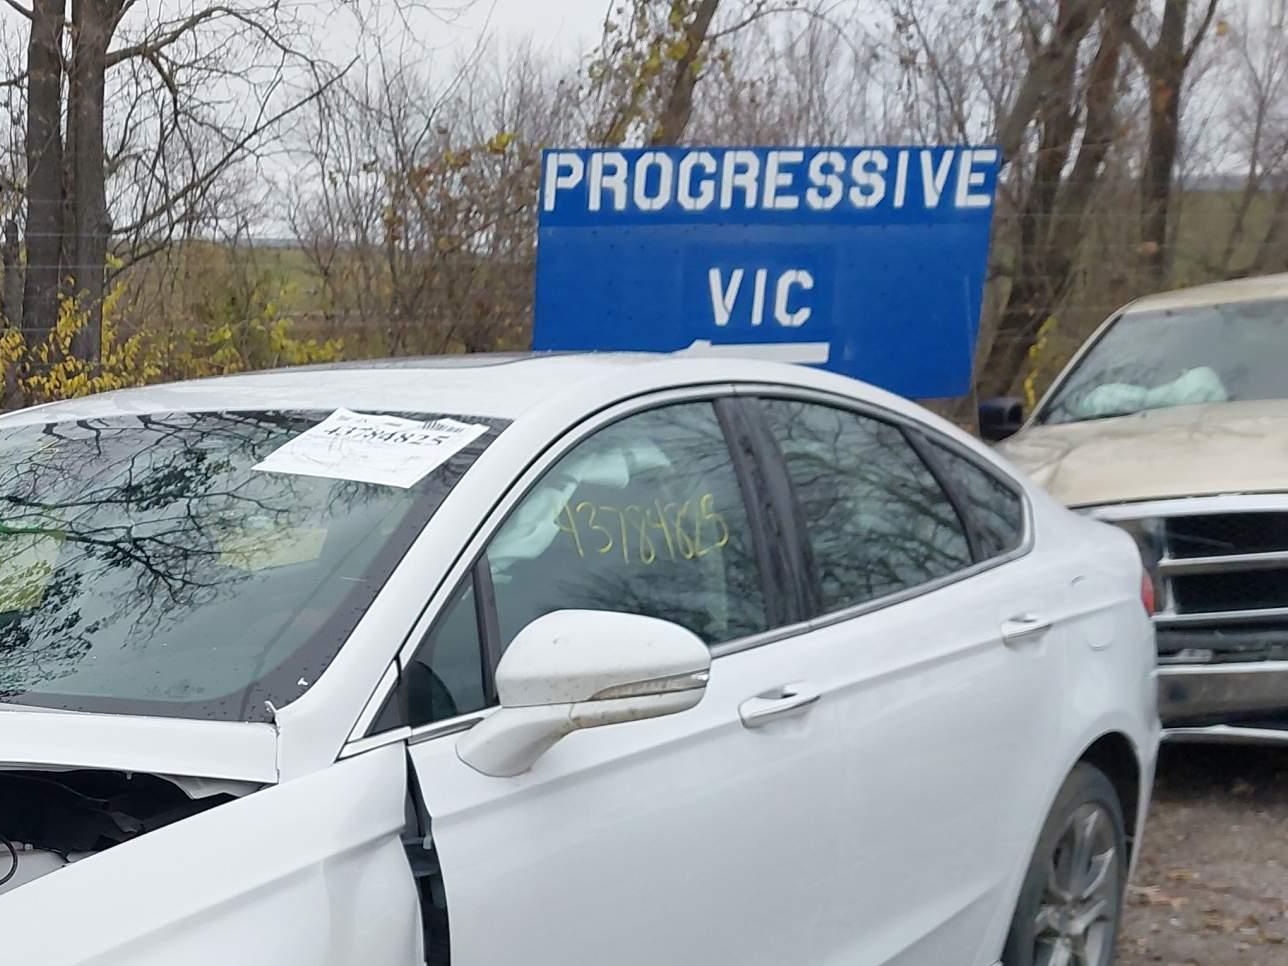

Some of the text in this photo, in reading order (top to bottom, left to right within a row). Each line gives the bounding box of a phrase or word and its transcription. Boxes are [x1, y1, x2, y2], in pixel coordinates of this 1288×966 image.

[543, 149, 998, 212] PROGRESSIVE
[708, 267, 814, 328] VIC
[324, 425, 451, 446] 43784825
